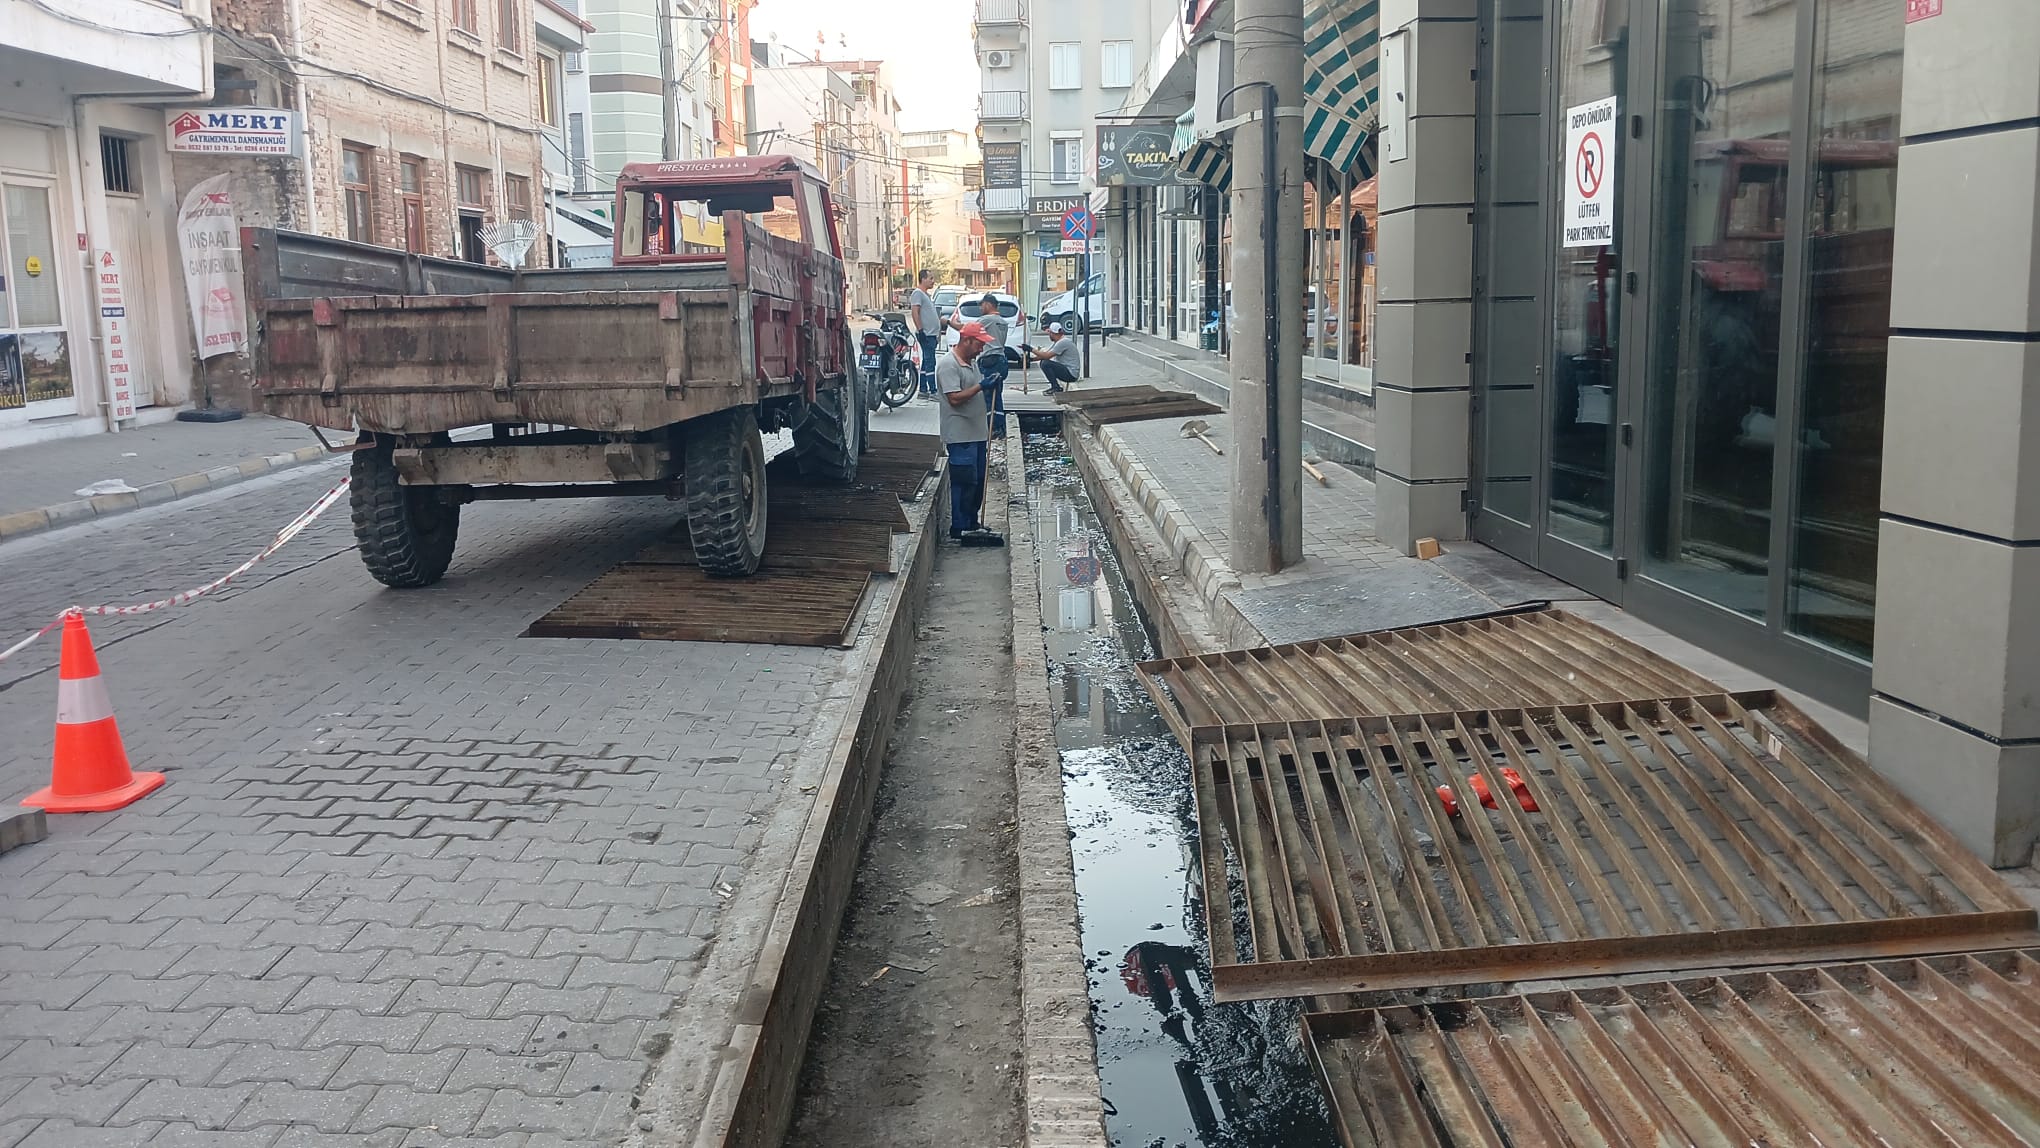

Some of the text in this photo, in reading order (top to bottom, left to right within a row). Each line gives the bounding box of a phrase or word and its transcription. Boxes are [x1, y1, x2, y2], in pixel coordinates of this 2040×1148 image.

[208, 114, 287, 130] MERT
[1572, 103, 1612, 130] DEPO ÖNÜDÜR
[238, 135, 286, 146] DANIŞMANLIĞI
[657, 163, 712, 172] PRESTIGE
[1578, 201, 1600, 219] LÜTFEN
[1566, 227, 1581, 242] PARK
[100, 273, 118, 284] MERT
